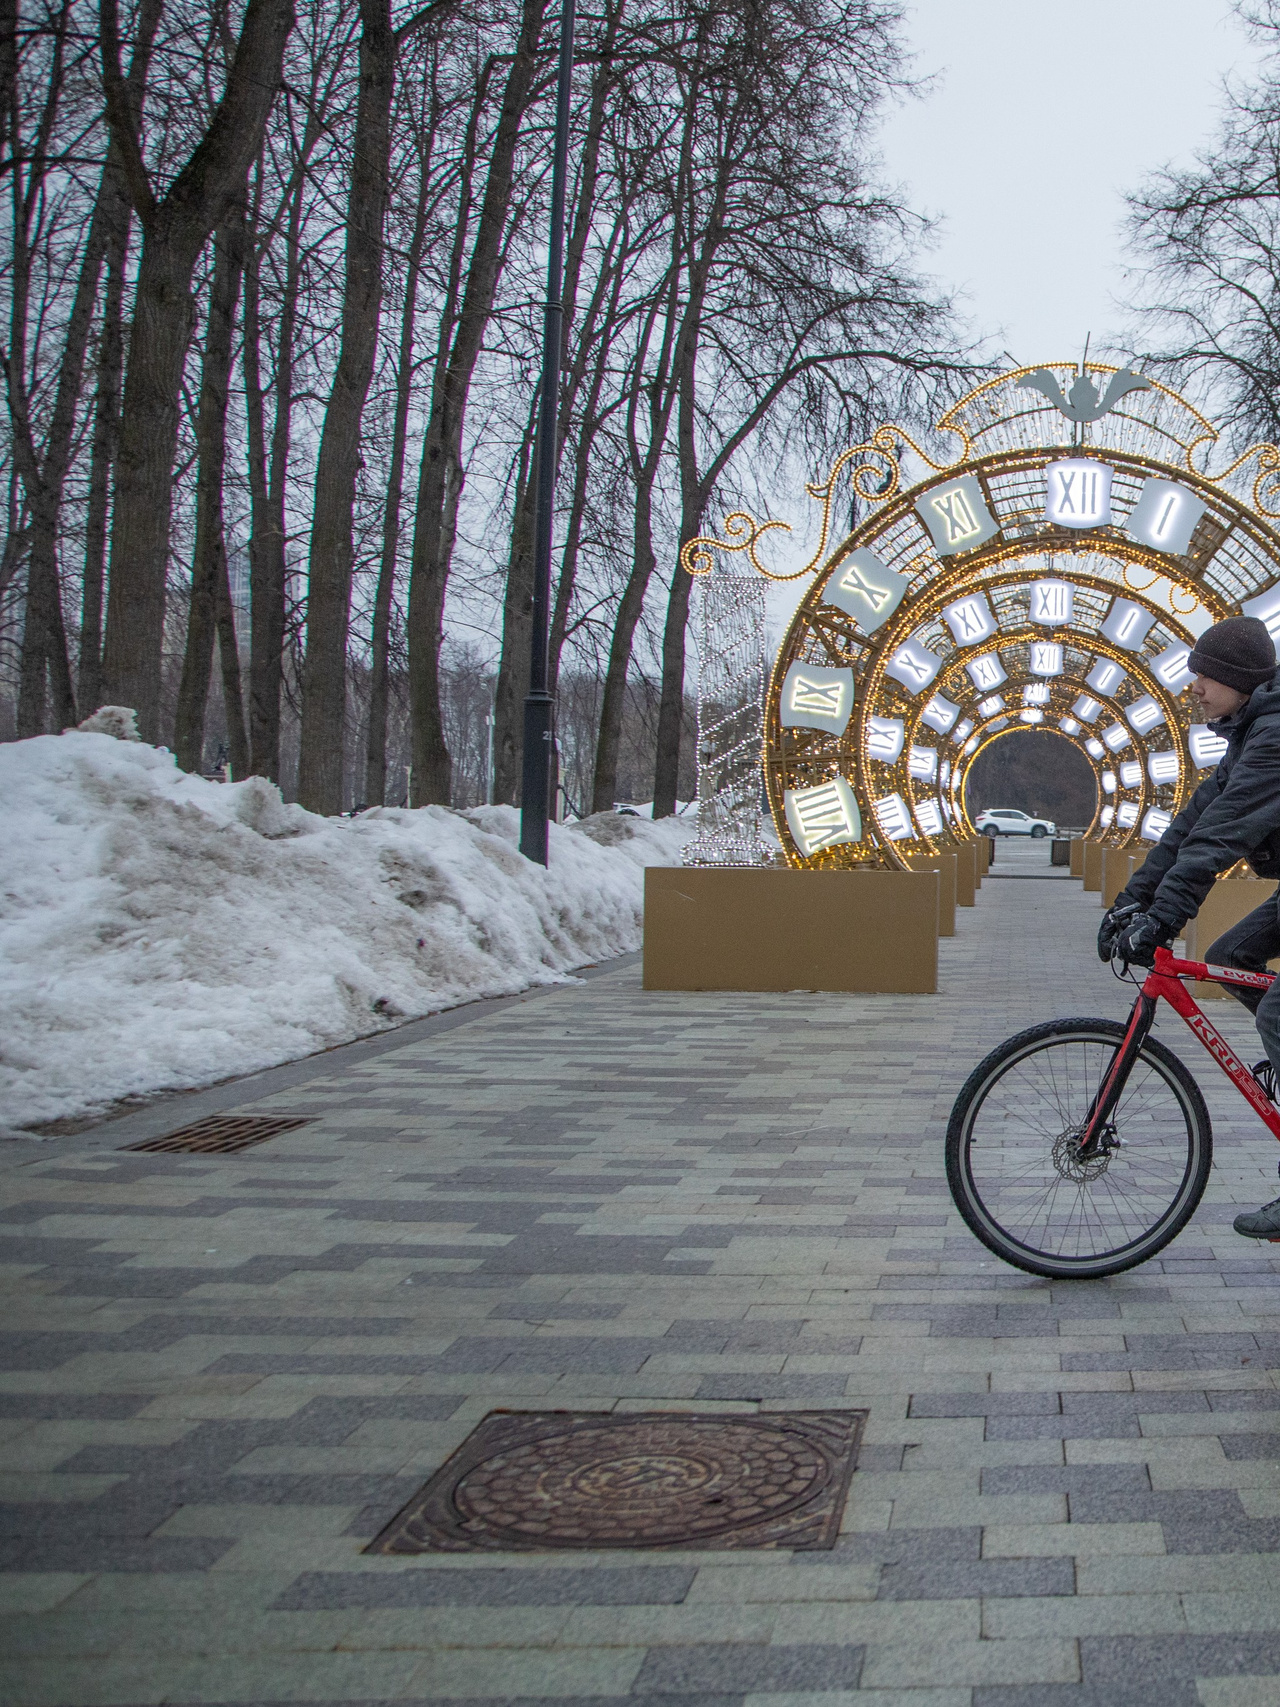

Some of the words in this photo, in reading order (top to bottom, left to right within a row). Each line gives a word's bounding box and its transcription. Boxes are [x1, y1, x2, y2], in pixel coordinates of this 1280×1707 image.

[1058, 471, 1098, 515] XII
[934, 490, 978, 540] XI
[1156, 496, 1176, 536] I
[842, 568, 889, 610] X
[1039, 587, 1064, 616] XII
[955, 603, 984, 637] XI
[1120, 611, 1137, 636] I
[899, 653, 928, 679] X
[975, 660, 998, 685] XI
[1037, 647, 1057, 670] XII
[793, 678, 841, 715] IX
[929, 704, 949, 722] X
[868, 725, 896, 750] IX
[1155, 759, 1177, 775] III
[795, 785, 850, 850] VIII
[1192, 1016, 1273, 1116] KROSS
